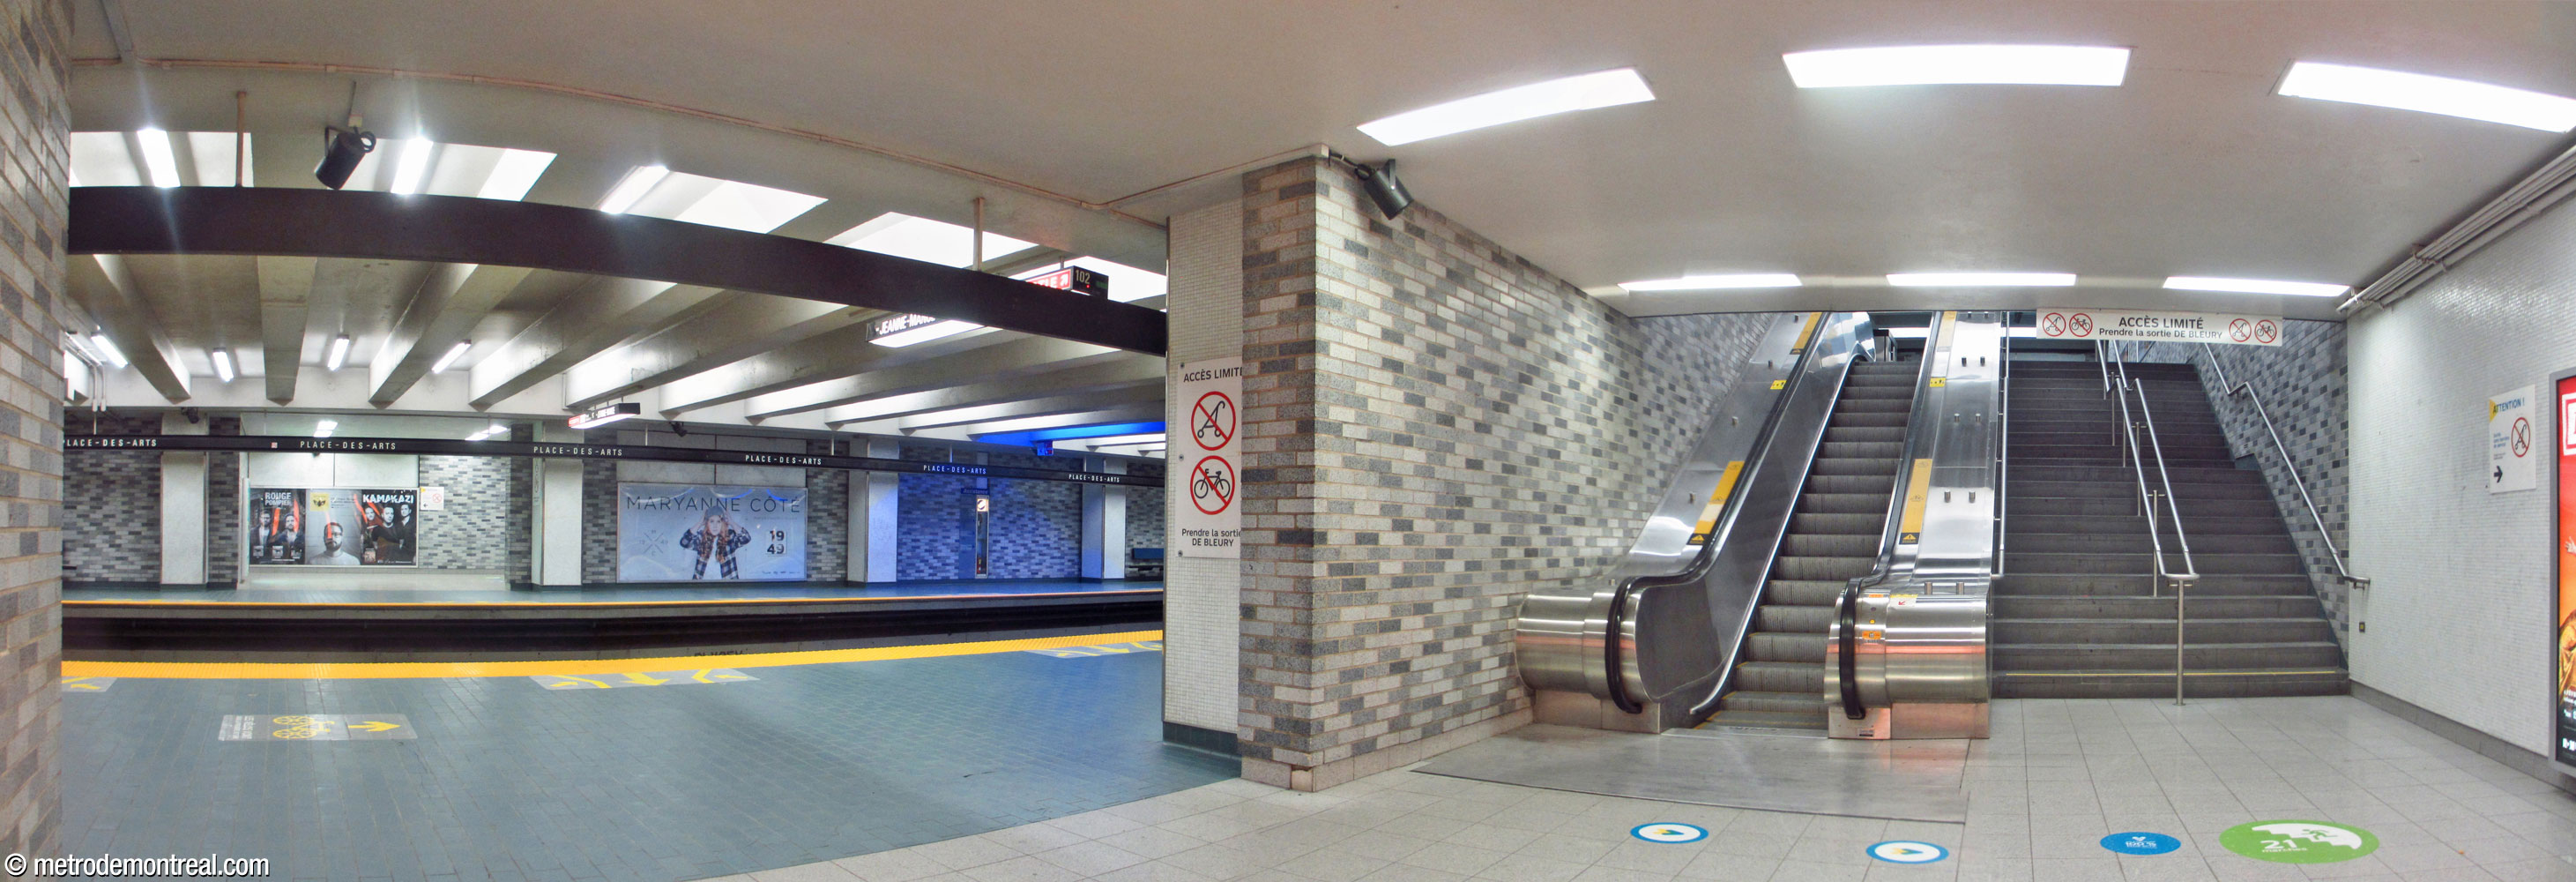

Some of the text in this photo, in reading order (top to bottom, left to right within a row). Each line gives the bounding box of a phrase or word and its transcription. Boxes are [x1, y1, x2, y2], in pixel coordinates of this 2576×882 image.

[1076, 269, 1091, 284] 102
[2118, 315, 2204, 330] ACCÈS LIMITÉ
[2099, 327, 2133, 336] Prendre
[2147, 329, 2171, 338] sortie
[2188, 331, 2222, 340] BLEURY
[1183, 369, 1211, 383] ACCÈS
[2493, 398, 2521, 414] ATTENTION
[300, 441, 396, 450] PLACE-DES-ARTS
[533, 446, 622, 456] PLACE-DES-ARTS
[745, 455, 822, 465] PLACE-DES-ARTS
[923, 465, 986, 475] PLACE-DES-ARTS
[1068, 474, 1120, 482] PLACE-DES-ARTS
[363, 494, 414, 504] KAMAKAZI
[627, 496, 800, 513] MARYANNE CÔTÉ
[770, 531, 785, 541] 19
[1203, 538, 1234, 547] BLEURY
[767, 543, 785, 554] 49
[2260, 840, 2297, 849] 21
